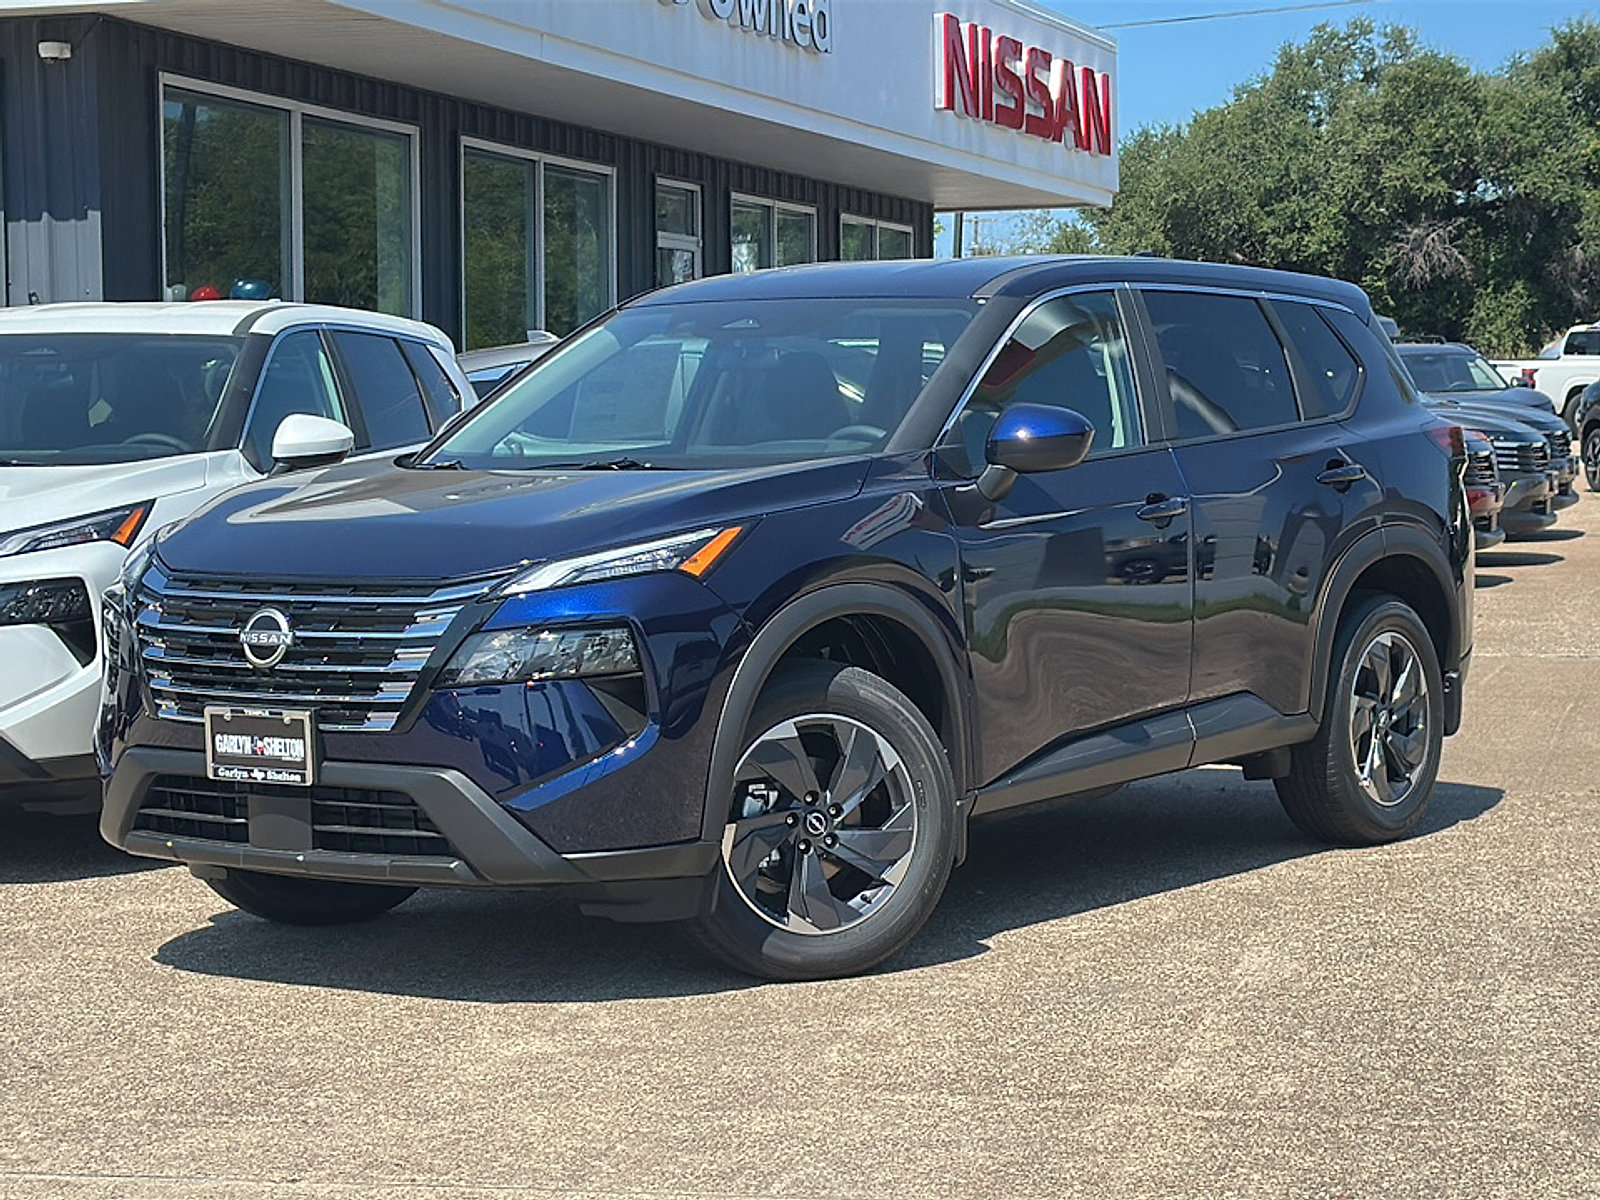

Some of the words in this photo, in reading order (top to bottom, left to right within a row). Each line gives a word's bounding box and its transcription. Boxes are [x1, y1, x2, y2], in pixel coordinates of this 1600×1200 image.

[935, 13, 1111, 156] NISSAN
[240, 632, 293, 645] NISSAN
[215, 734, 252, 754] GARLYN
[263, 737, 304, 757] SHELTON
